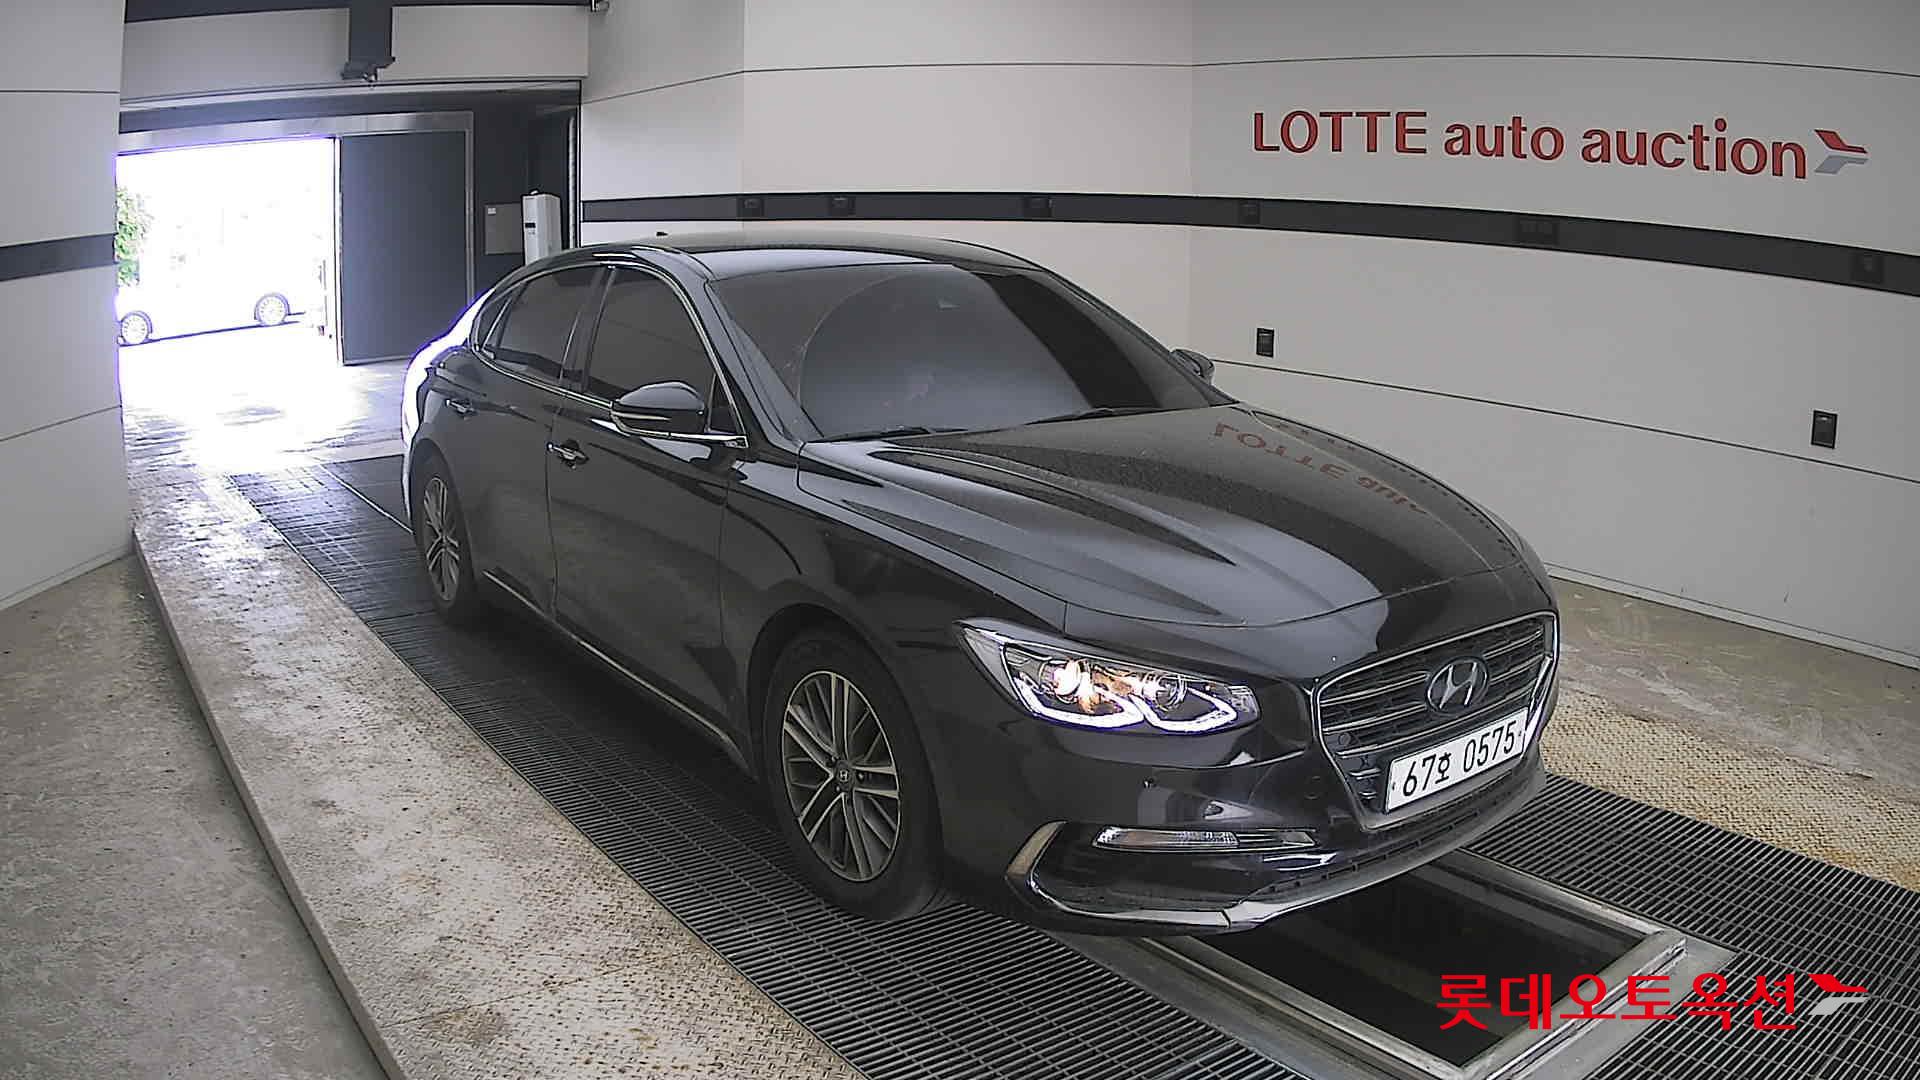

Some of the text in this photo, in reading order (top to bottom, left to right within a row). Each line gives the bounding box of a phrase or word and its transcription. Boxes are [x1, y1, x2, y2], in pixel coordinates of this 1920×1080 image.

[1252, 110, 1807, 179] LOTTE auto auction
[1403, 720, 1517, 797] 67호 0575
